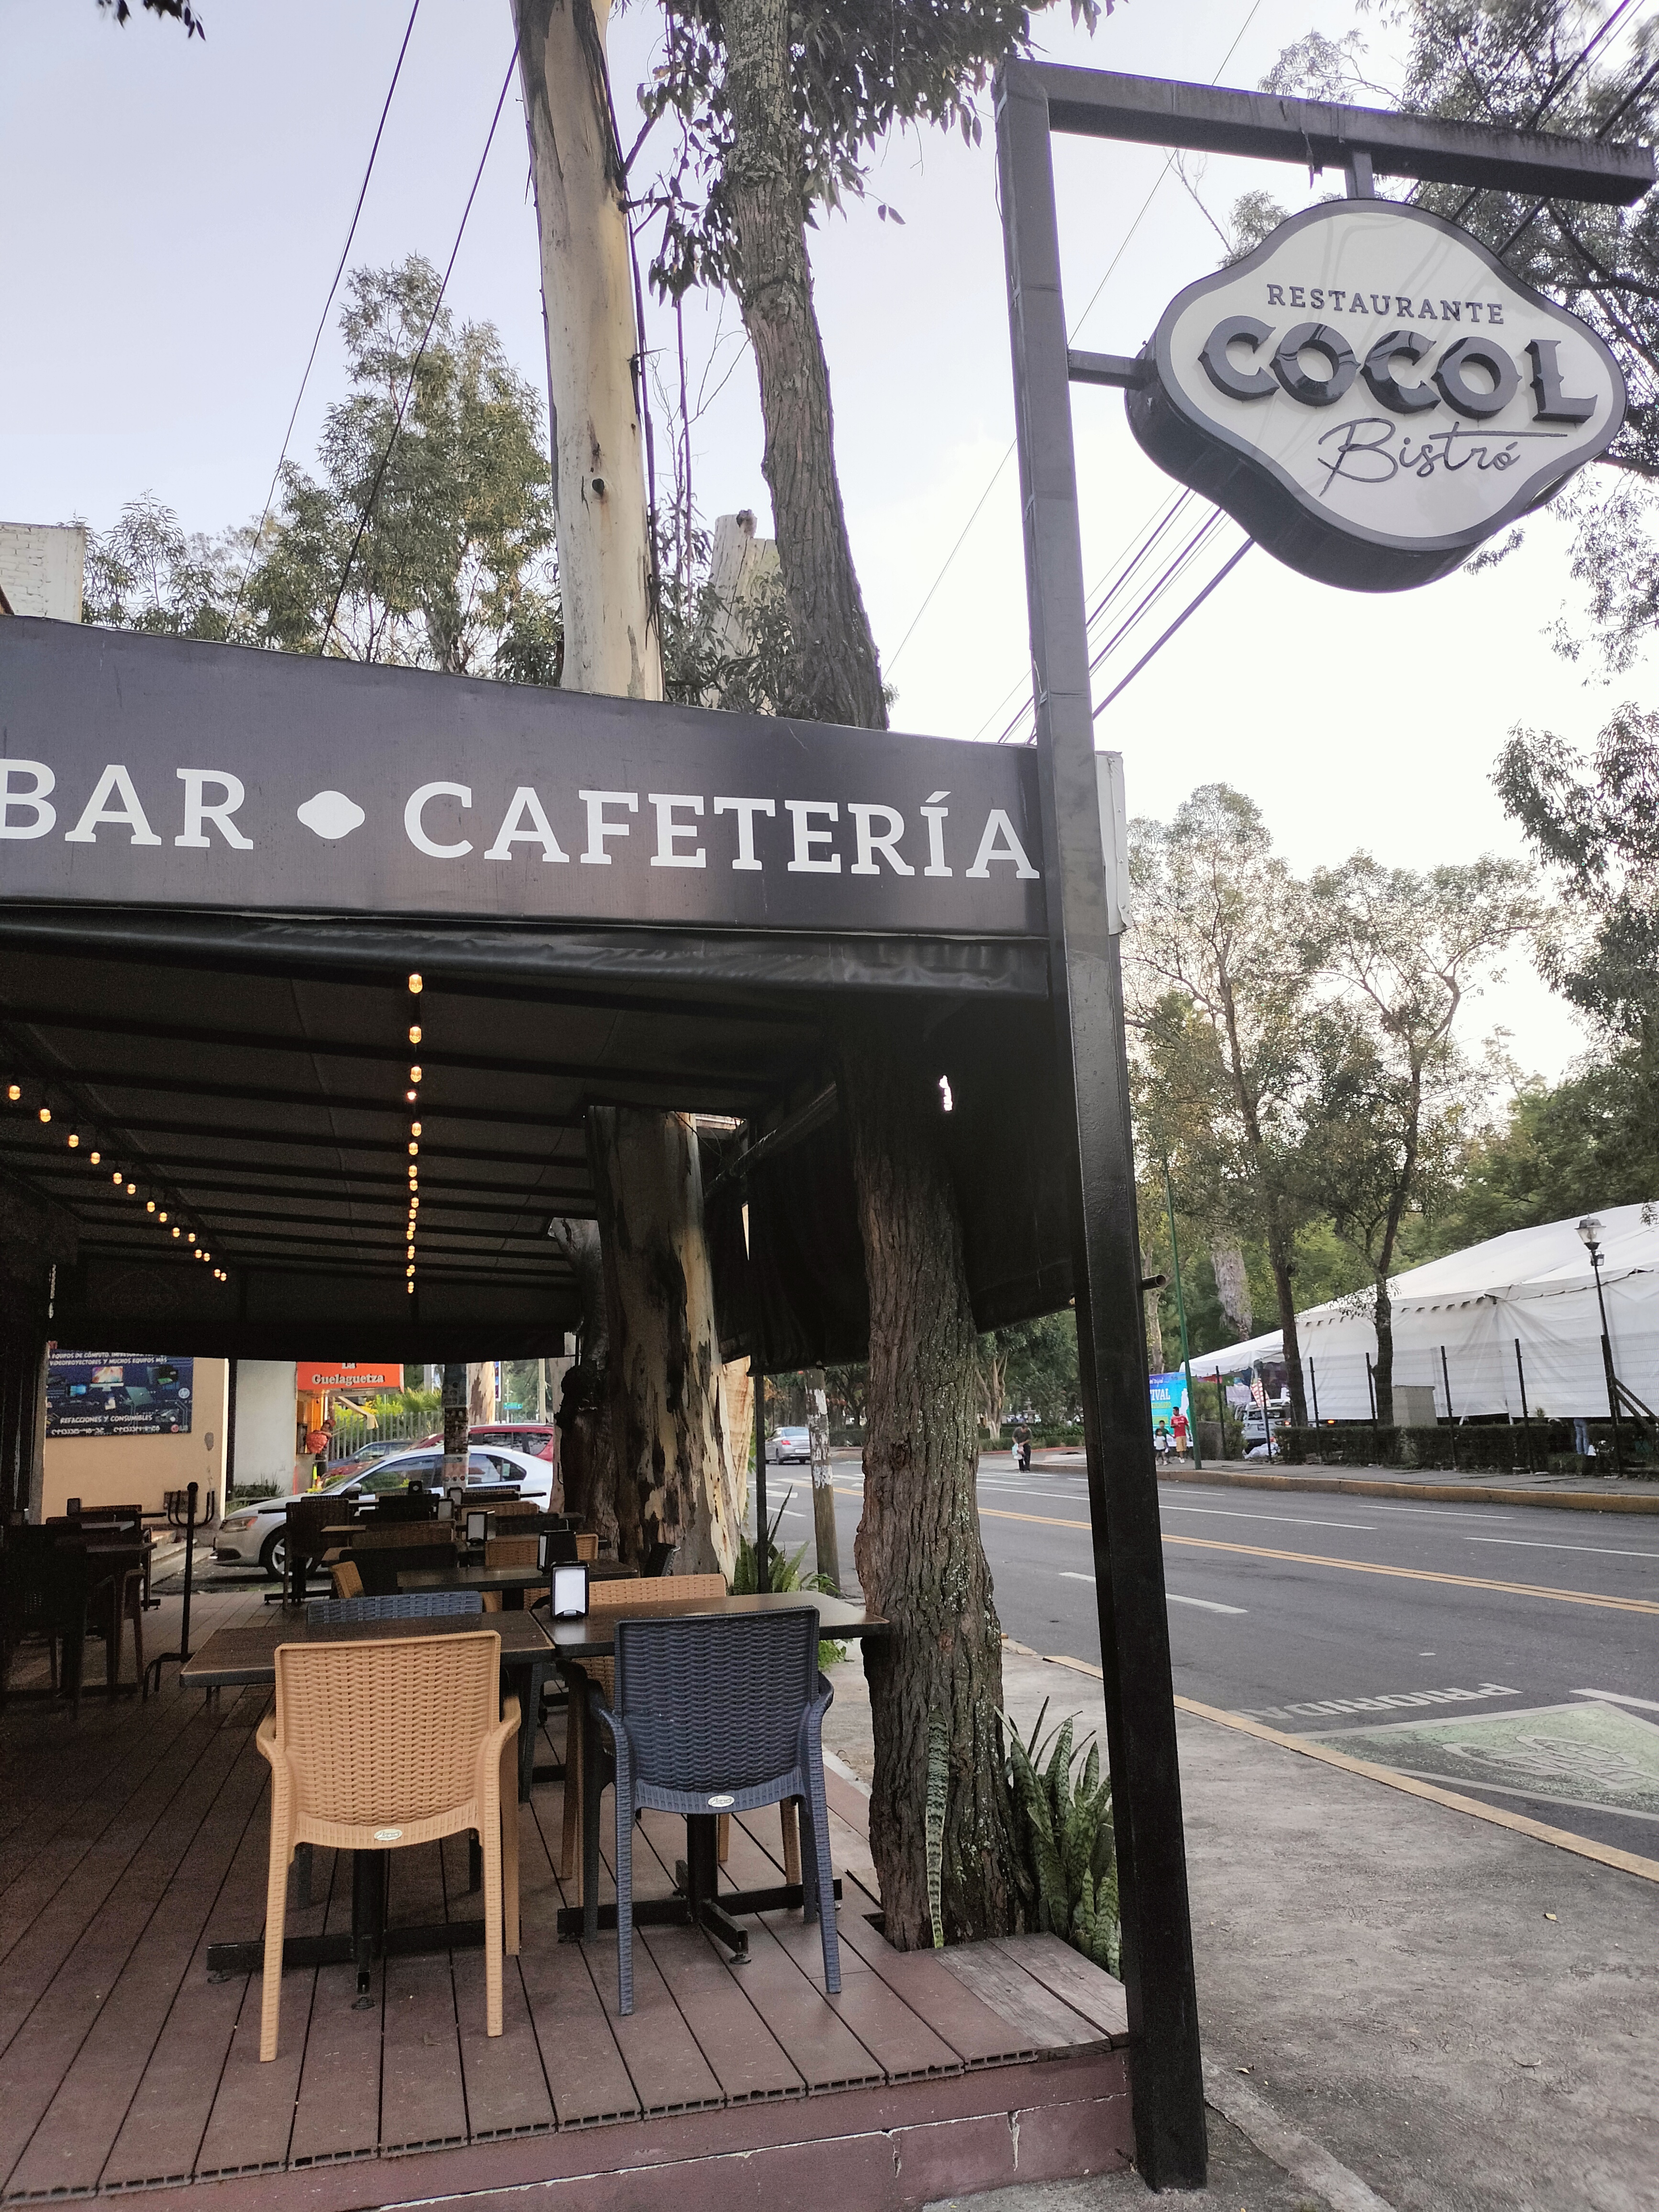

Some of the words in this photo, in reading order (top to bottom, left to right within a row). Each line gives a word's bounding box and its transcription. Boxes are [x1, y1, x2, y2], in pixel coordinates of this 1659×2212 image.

[1266, 284, 1505, 324] RESTAURANTE
[1197, 315, 1598, 424] COCOL
[1317, 417, 1568, 497] Bistró
[0, 758, 254, 850] BAR
[403, 780, 1040, 880] CAFETERÍA
[312, 1374, 384, 1386] Guelaguetza
